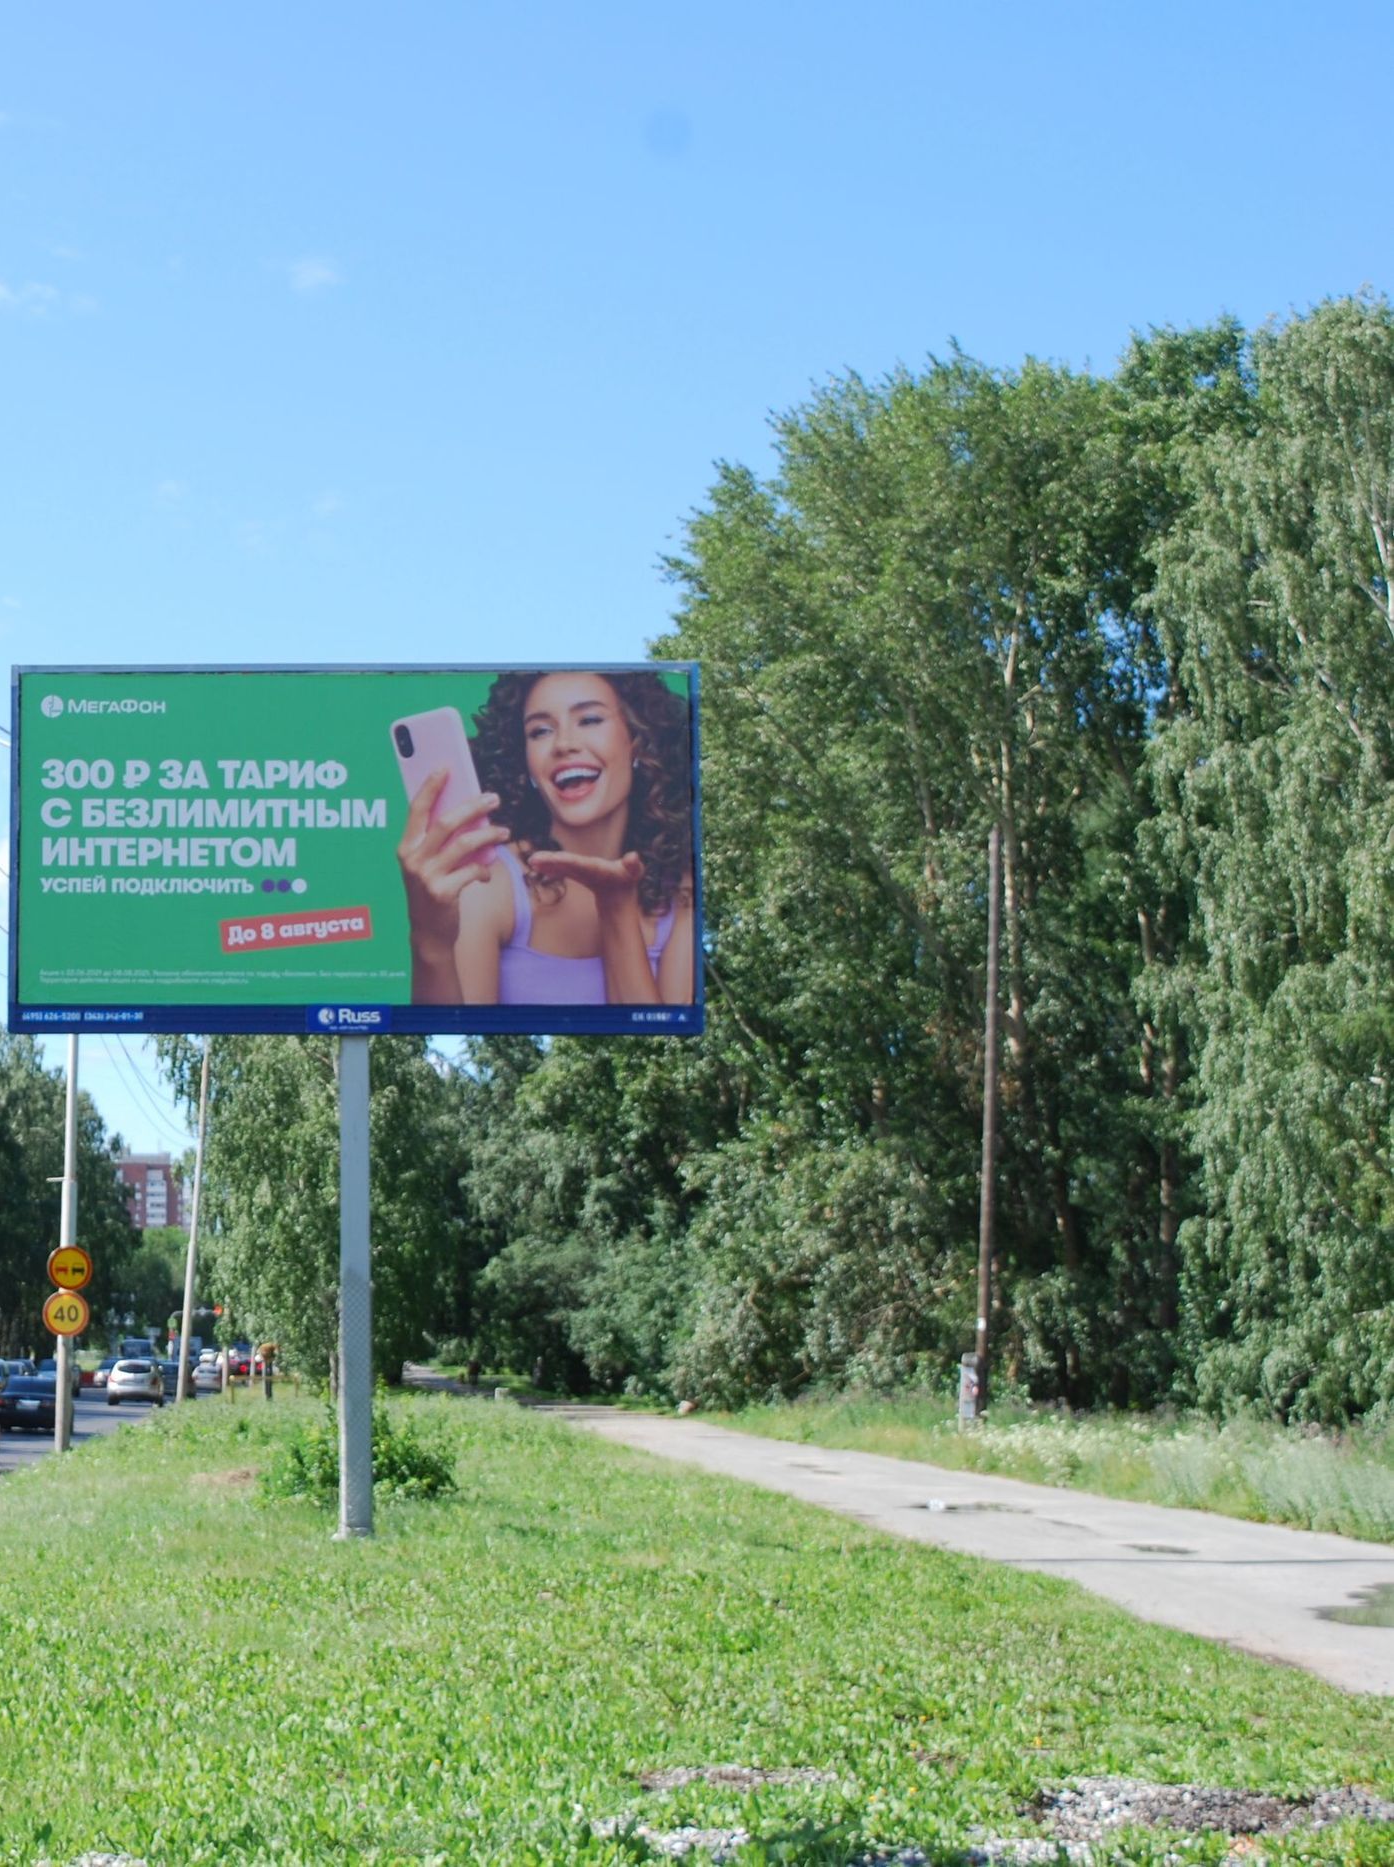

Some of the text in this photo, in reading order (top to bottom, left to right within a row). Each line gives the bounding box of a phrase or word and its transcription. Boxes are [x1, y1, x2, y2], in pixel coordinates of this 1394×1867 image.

[40, 758, 115, 790] 300
[158, 758, 210, 790] ЗА
[217, 759, 348, 790] ТАРИФ
[40, 797, 387, 829] С БЕЗЛИМИТНЫМ
[41, 836, 297, 868] ИНТЕРНЕТОМ
[39, 874, 255, 896] УСПЕЙ ПОДКЛЮЧИТЬ
[227, 917, 364, 946] До 8 августа
[338, 1008, 382, 1024] Russ
[53, 1304, 79, 1323] 40
